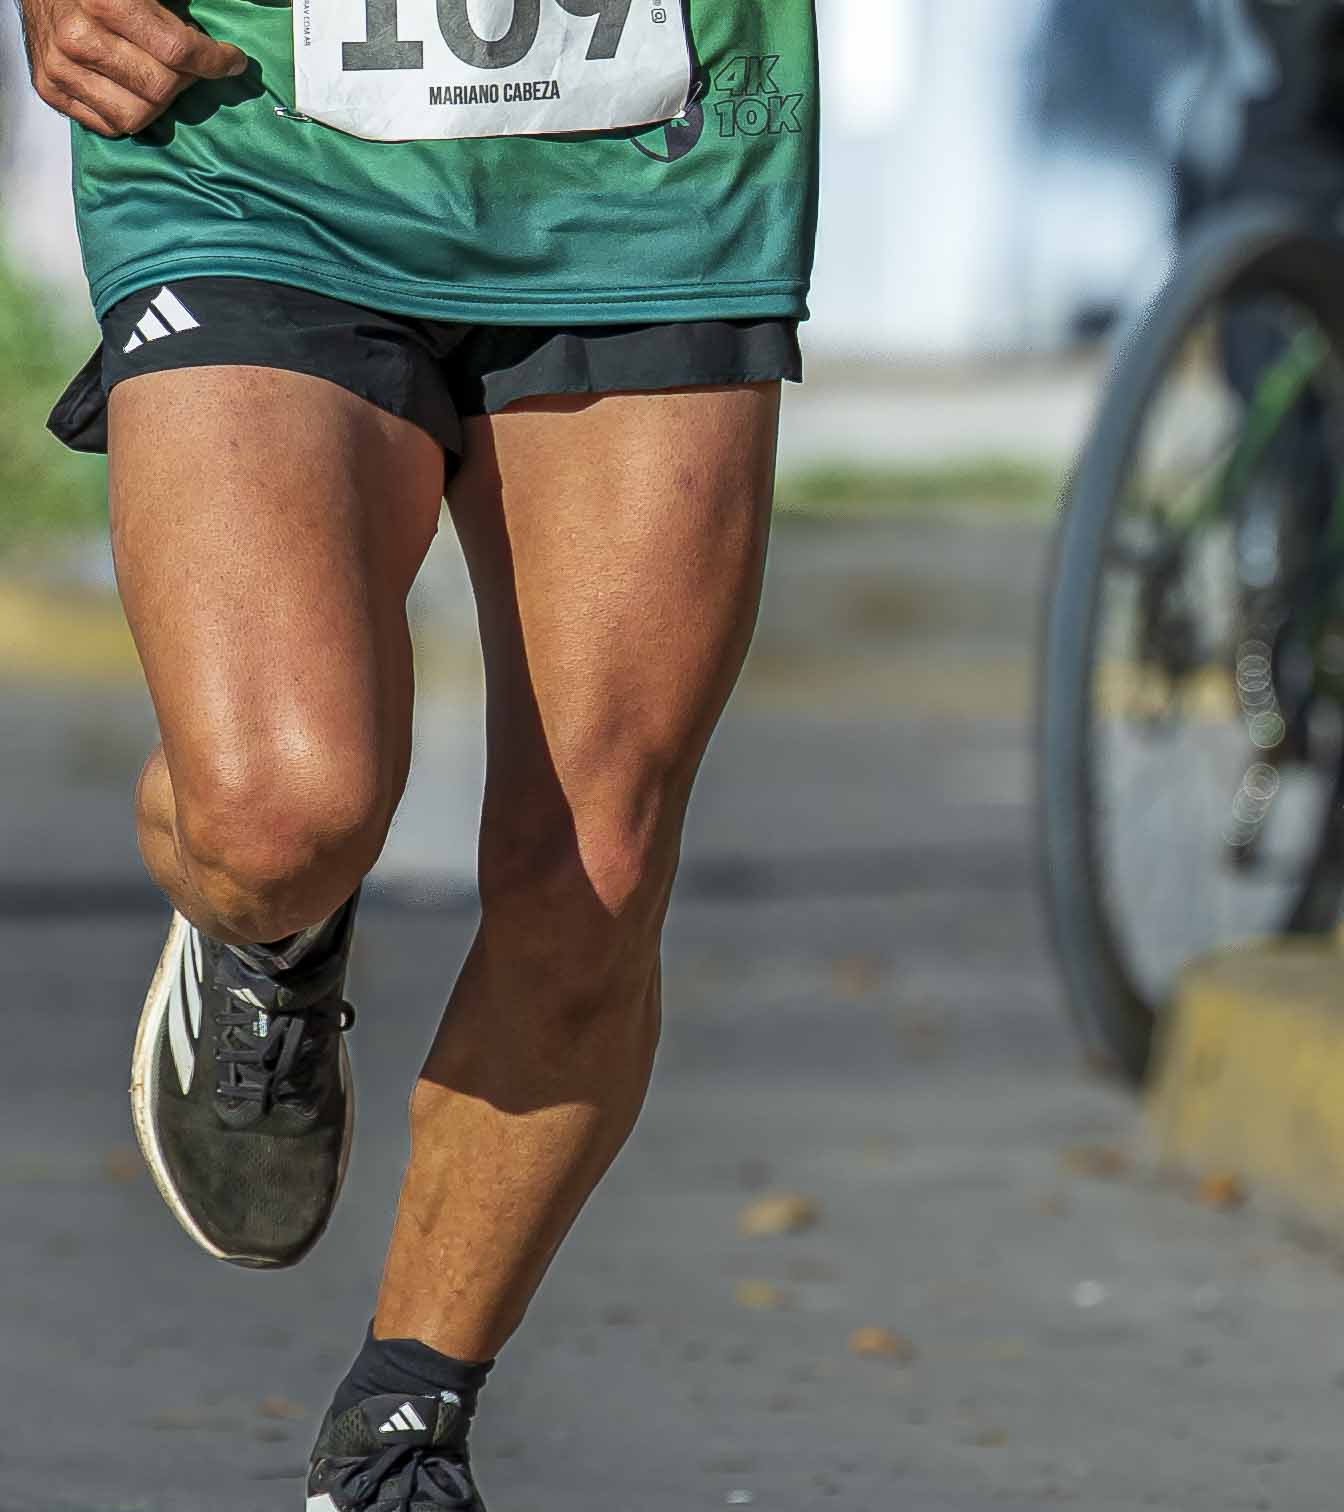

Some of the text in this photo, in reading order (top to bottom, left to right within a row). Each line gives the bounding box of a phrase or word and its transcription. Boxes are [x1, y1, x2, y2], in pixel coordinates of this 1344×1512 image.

[429, 79, 561, 106] MARIANO CABEZA
[714, 55, 780, 96] 4K
[713, 93, 804, 138] 10K
